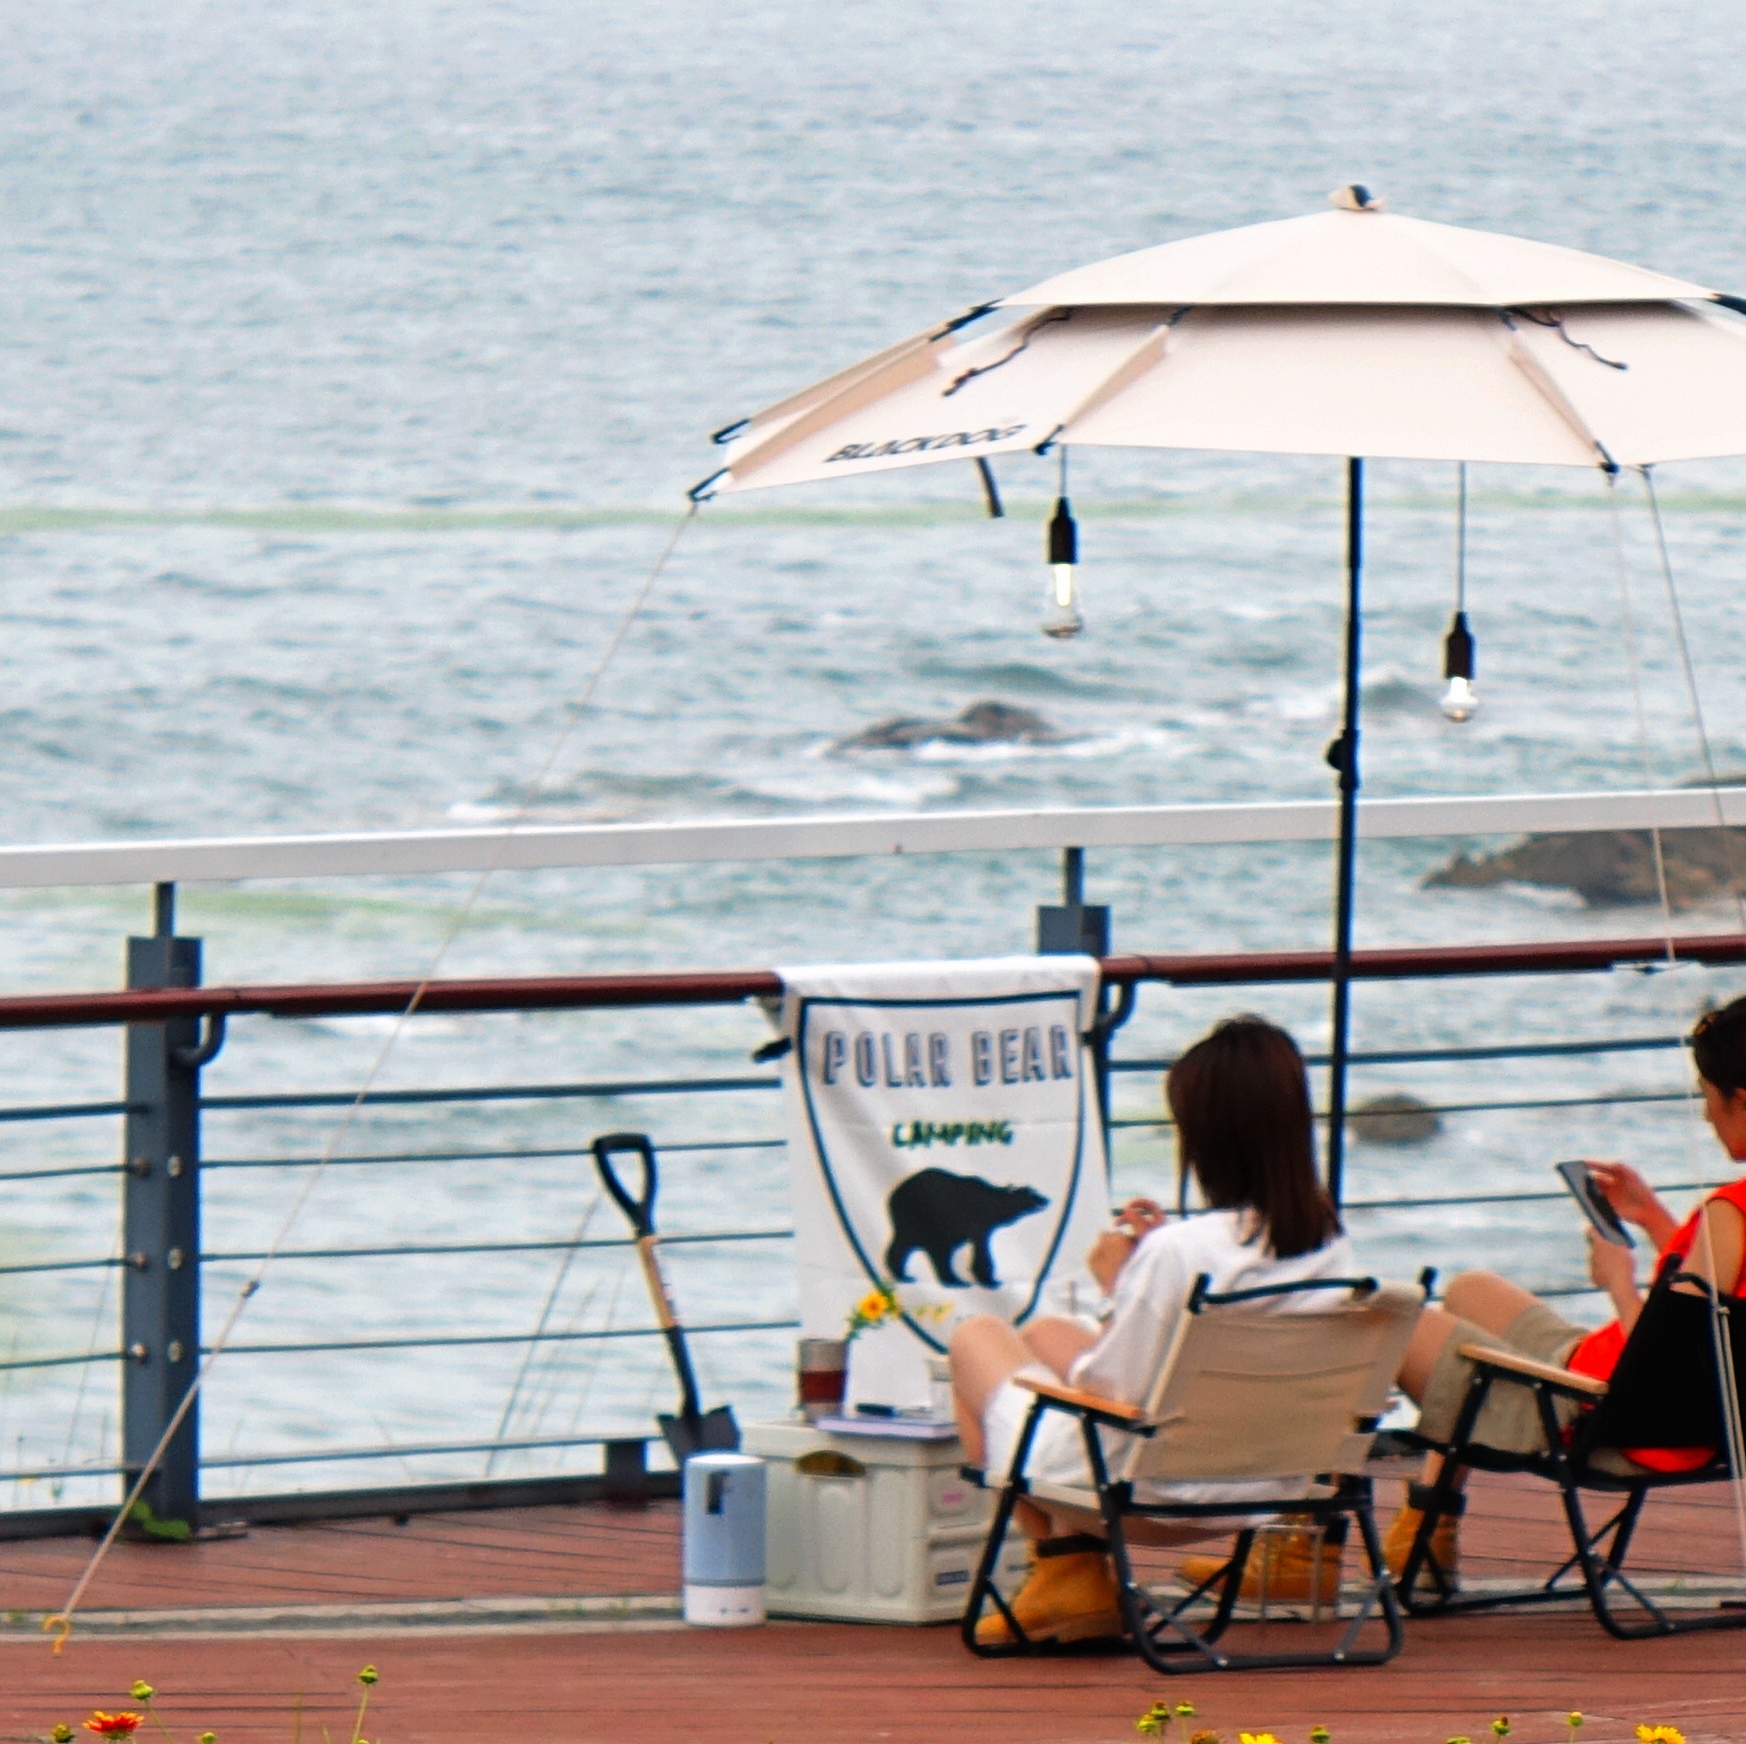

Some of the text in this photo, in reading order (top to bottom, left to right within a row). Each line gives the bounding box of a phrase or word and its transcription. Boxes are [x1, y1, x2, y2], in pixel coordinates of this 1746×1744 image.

[825, 424, 1028, 462] BLACKDOG
[824, 1025, 1073, 1087] POLAR BEAR
[892, 1120, 1014, 1147] CAMPING
